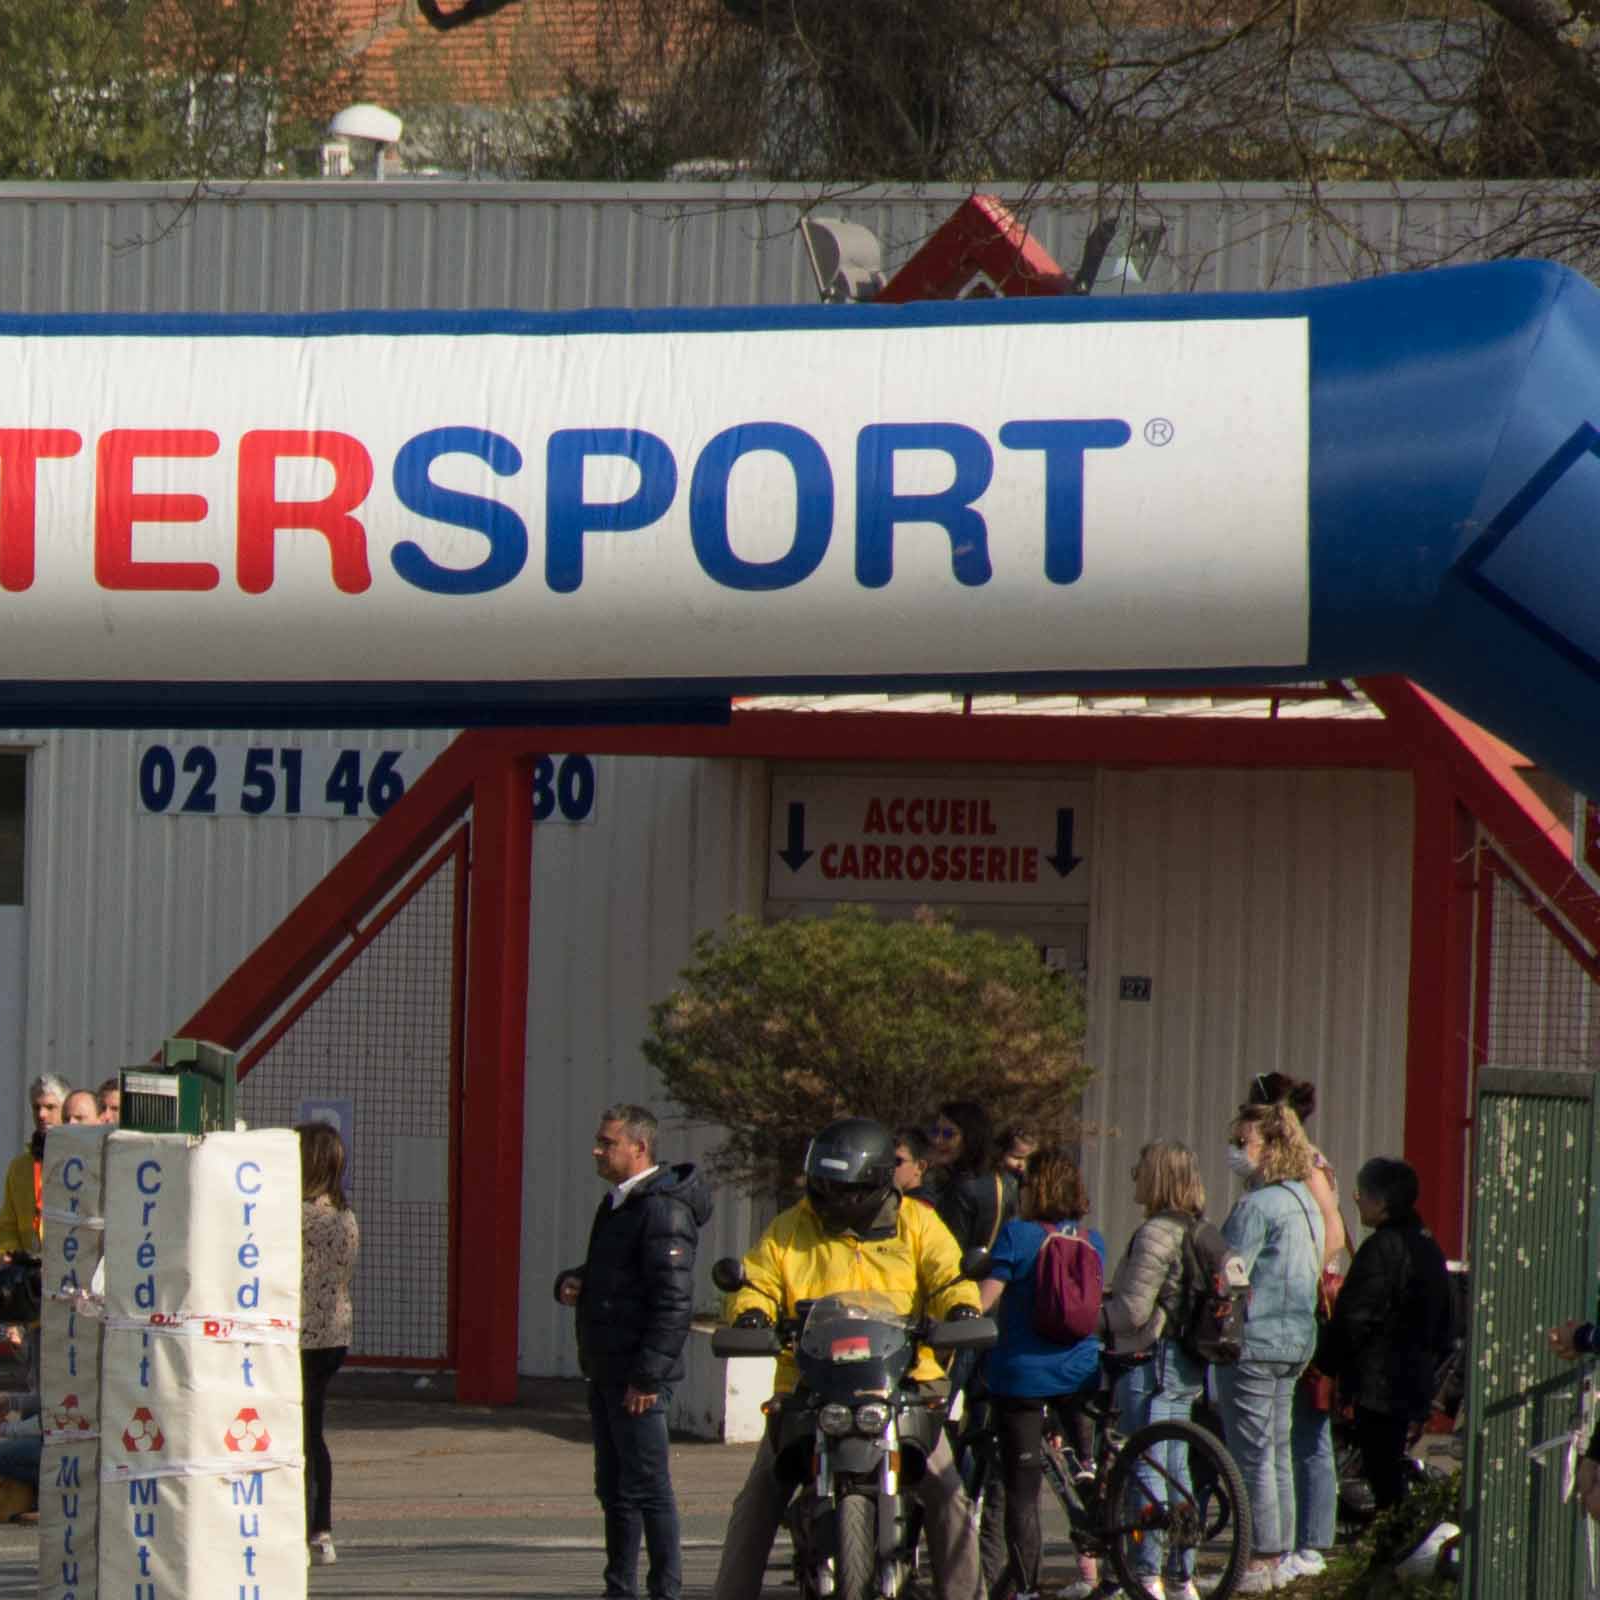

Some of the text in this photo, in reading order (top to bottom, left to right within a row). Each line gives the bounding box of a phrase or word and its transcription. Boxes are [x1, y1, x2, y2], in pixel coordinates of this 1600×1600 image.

[138, 745, 218, 814] 02
[239, 747, 302, 815] 51
[324, 749, 404, 817] 46
[862, 797, 997, 836] ACCUEIL
[818, 842, 1041, 883] CARROSSERIE
